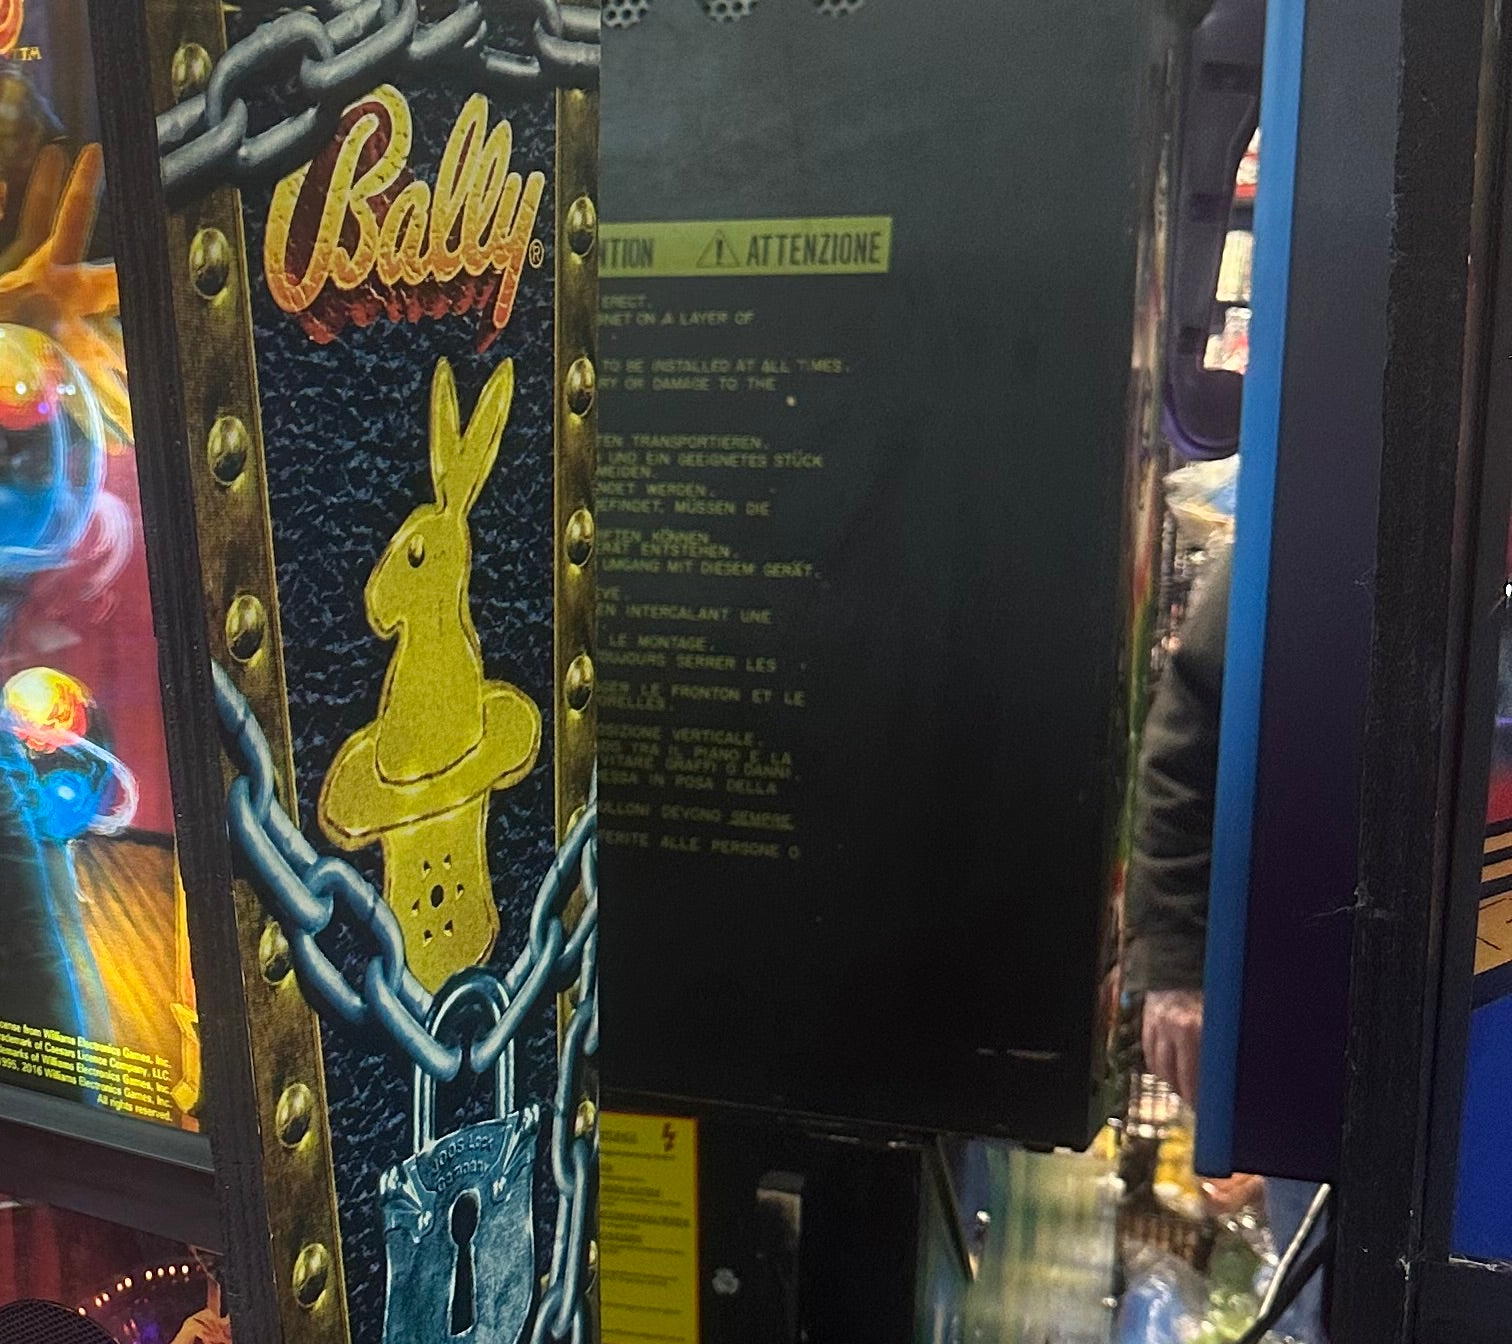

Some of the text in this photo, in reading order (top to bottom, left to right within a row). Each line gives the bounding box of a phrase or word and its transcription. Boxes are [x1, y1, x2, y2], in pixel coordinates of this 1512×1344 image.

[598, 231, 884, 270] TION ATTENZIONE
[22, 1023, 42, 1037] from
[42, 1028, 76, 1046] Williams
[77, 1036, 121, 1056] Electronics
[122, 1047, 154, 1065] Games,
[155, 1054, 172, 1068] Inc.
[34, 1040, 43, 1050] of
[152, 1067, 172, 1082] LLC.
[21, 1061, 43, 1076] 2016
[44, 1068, 77, 1085] Williams
[78, 1076, 122, 1096] Electronics
[123, 1087, 155, 1105] Games,
[156, 1095, 173, 1108] Inc.
[30, 1052, 40, 1063] of
[41, 1054, 75, 1071] Williams
[76, 1062, 121, 1082] Electronics
[122, 1074, 154, 1092] Games,
[97, 1094, 173, 1122] All rights reserved.
